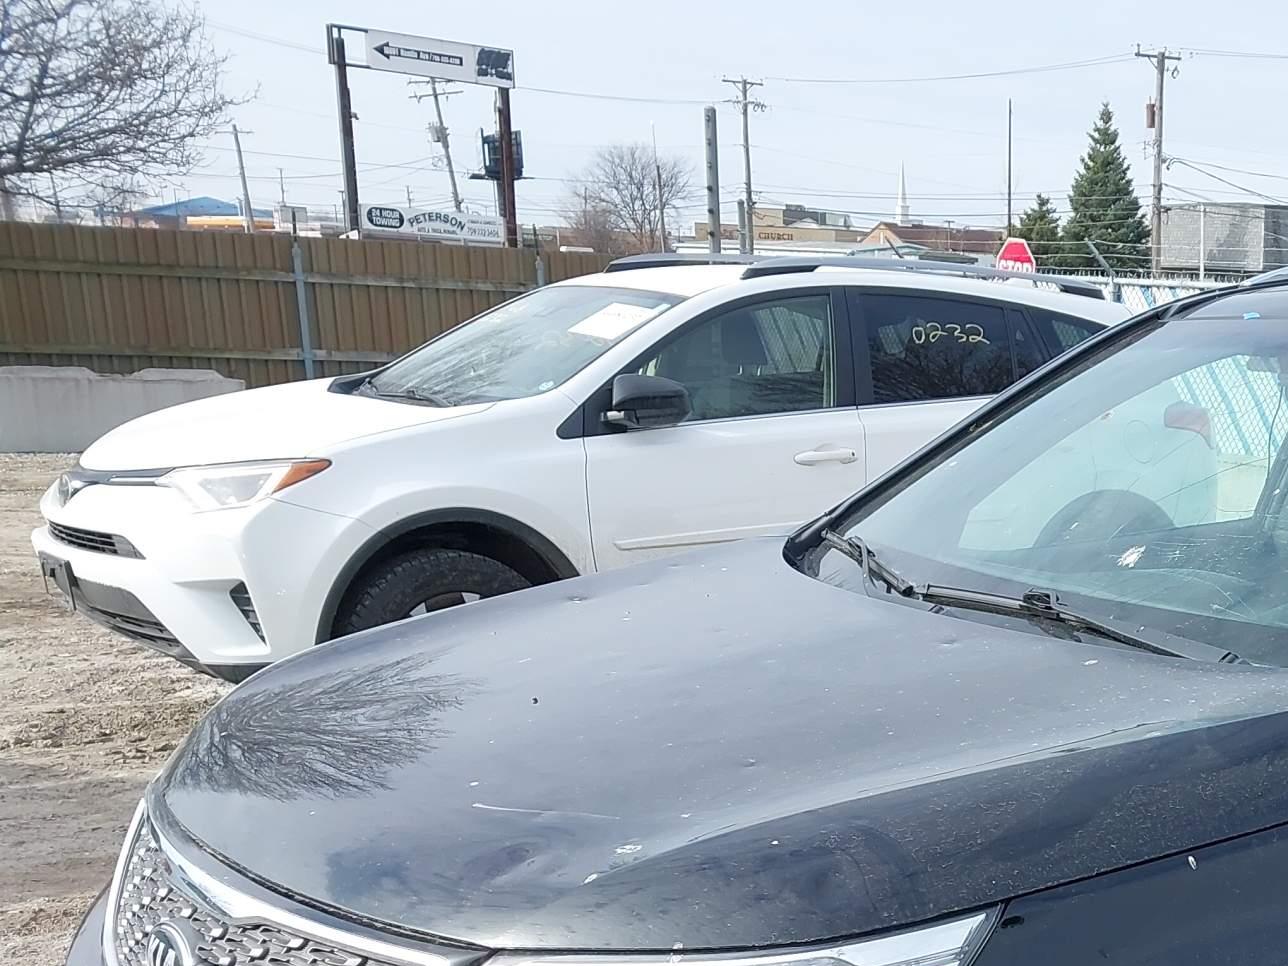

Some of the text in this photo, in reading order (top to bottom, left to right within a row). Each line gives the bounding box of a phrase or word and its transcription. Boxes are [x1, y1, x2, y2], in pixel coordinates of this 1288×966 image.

[371, 208, 399, 219] 24 HOUR
[372, 216, 400, 227] TOWING
[408, 212, 466, 231] PETERSON
[758, 232, 793, 241] CHURCH
[999, 259, 1033, 272] STOP
[912, 322, 991, 344] 0232
